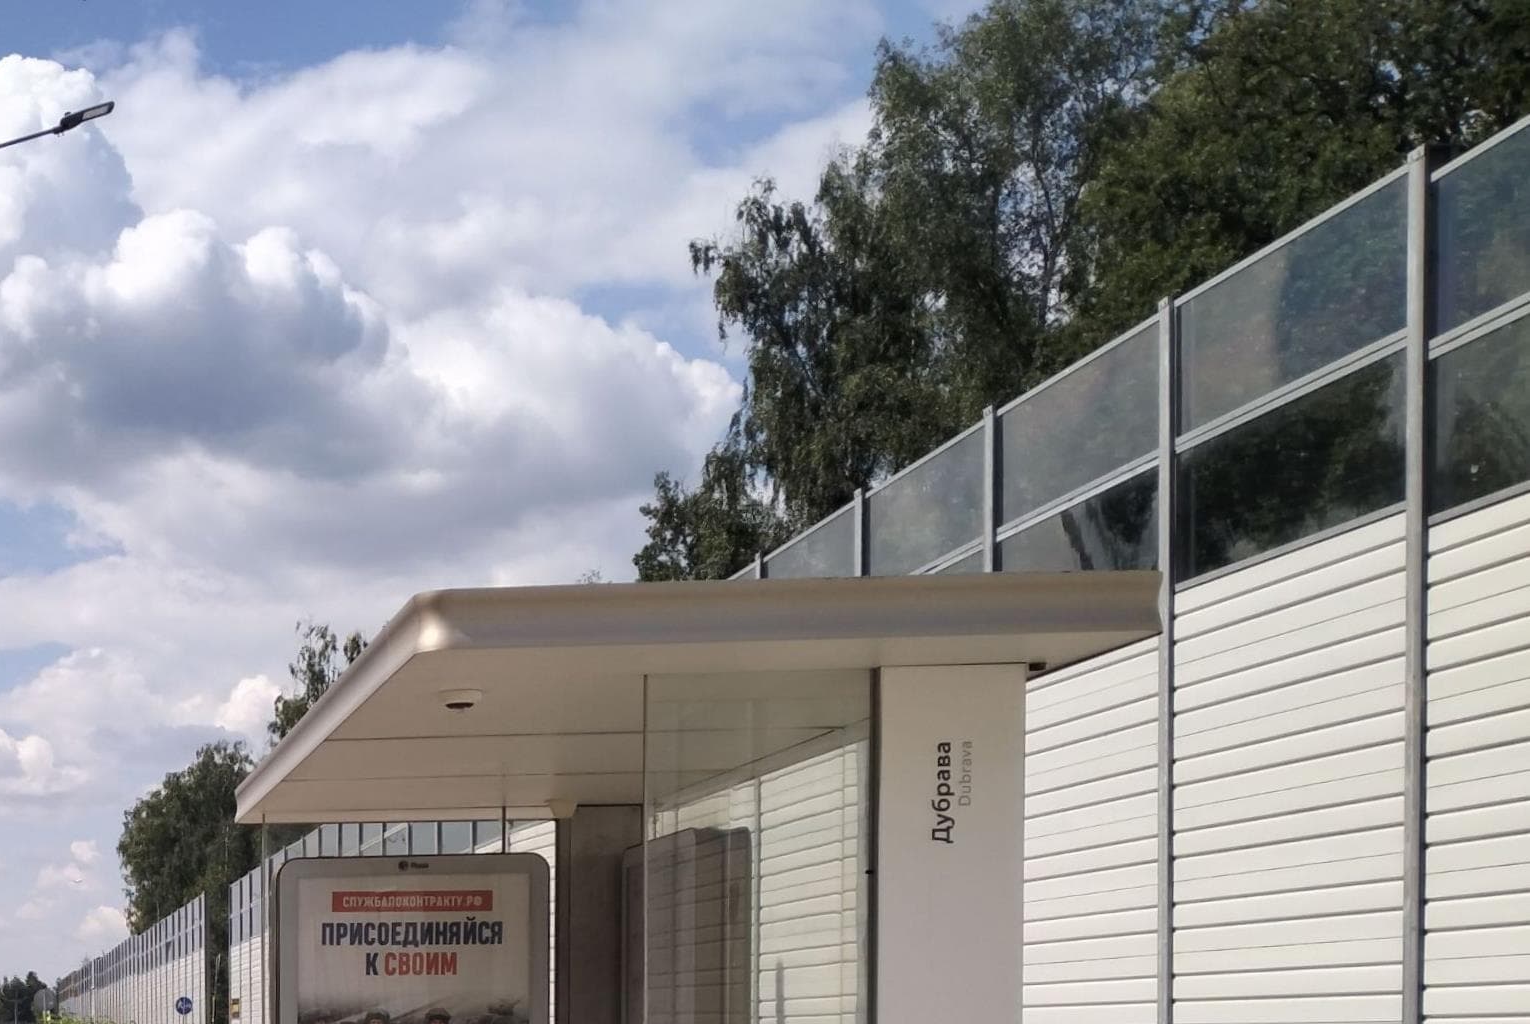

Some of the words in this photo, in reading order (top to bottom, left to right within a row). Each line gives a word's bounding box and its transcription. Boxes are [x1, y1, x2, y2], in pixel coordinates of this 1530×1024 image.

[932, 741, 955, 844] Дубрава
[958, 741, 972, 806] Dubrava
[321, 916, 503, 948] ПРИСОЕДИНЯЙСЯ
[365, 952, 379, 976] К
[384, 952, 457, 976] СВОИМ
